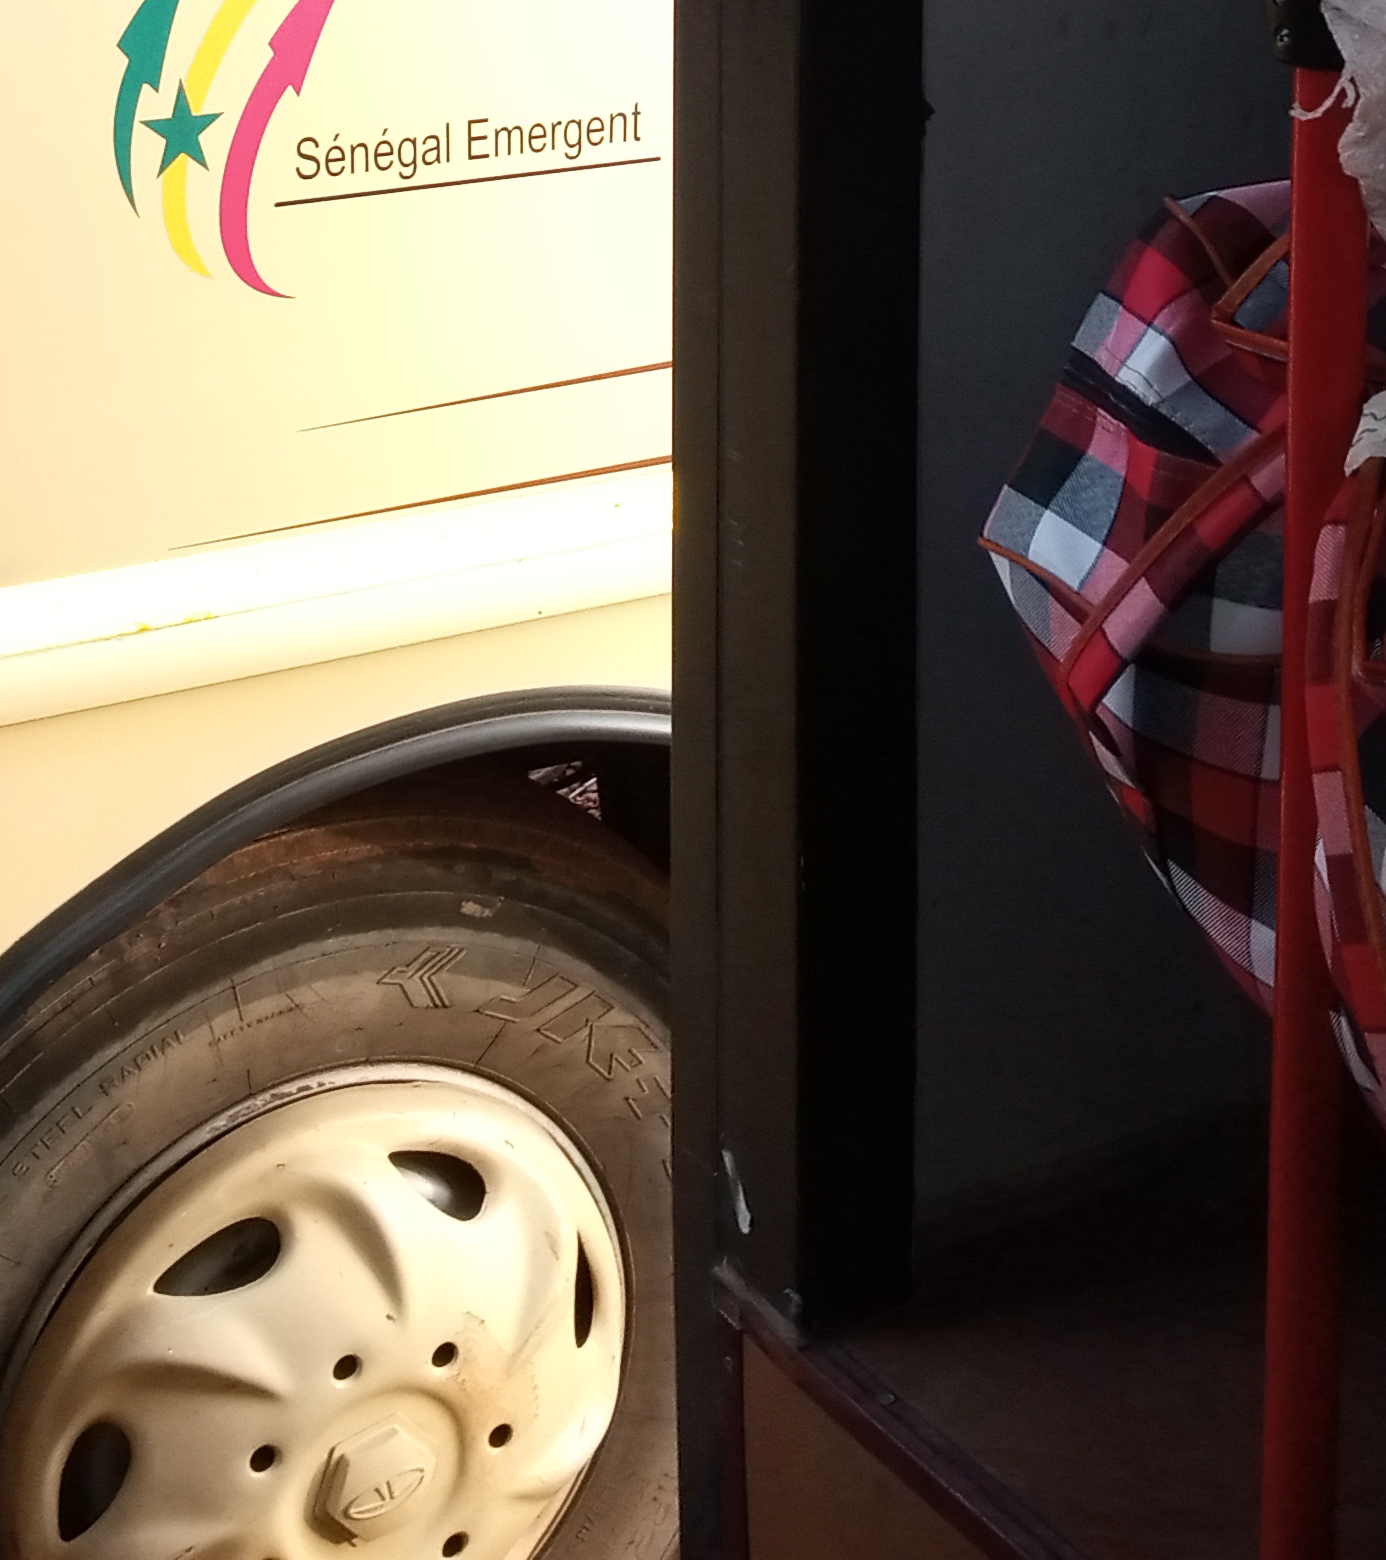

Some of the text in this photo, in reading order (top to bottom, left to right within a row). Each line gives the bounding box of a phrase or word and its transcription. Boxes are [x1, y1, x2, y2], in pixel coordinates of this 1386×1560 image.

[295, 101, 642, 180] Sénégal Emergent
[11, 1104, 94, 1180] STEEL
[98, 1028, 190, 1097] RADIAL
